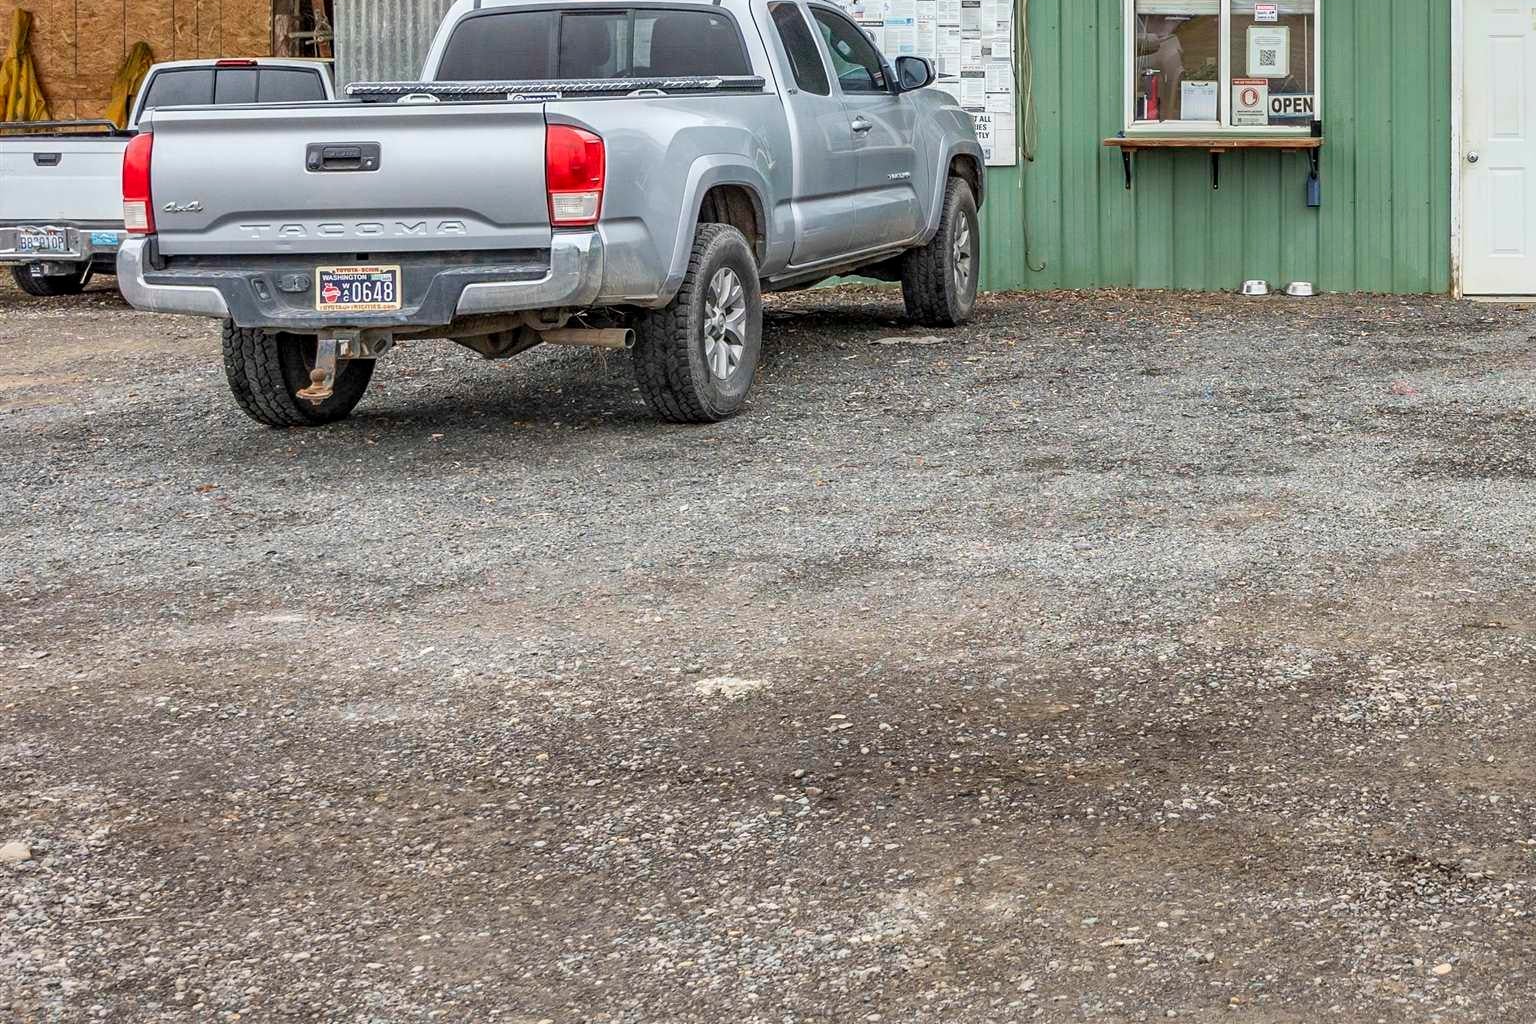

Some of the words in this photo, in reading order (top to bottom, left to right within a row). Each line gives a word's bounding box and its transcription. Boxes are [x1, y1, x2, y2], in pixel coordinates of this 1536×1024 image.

[1271, 97, 1313, 113] OPEN
[240, 220, 468, 238] TACOMA
[352, 281, 393, 302] 0648
